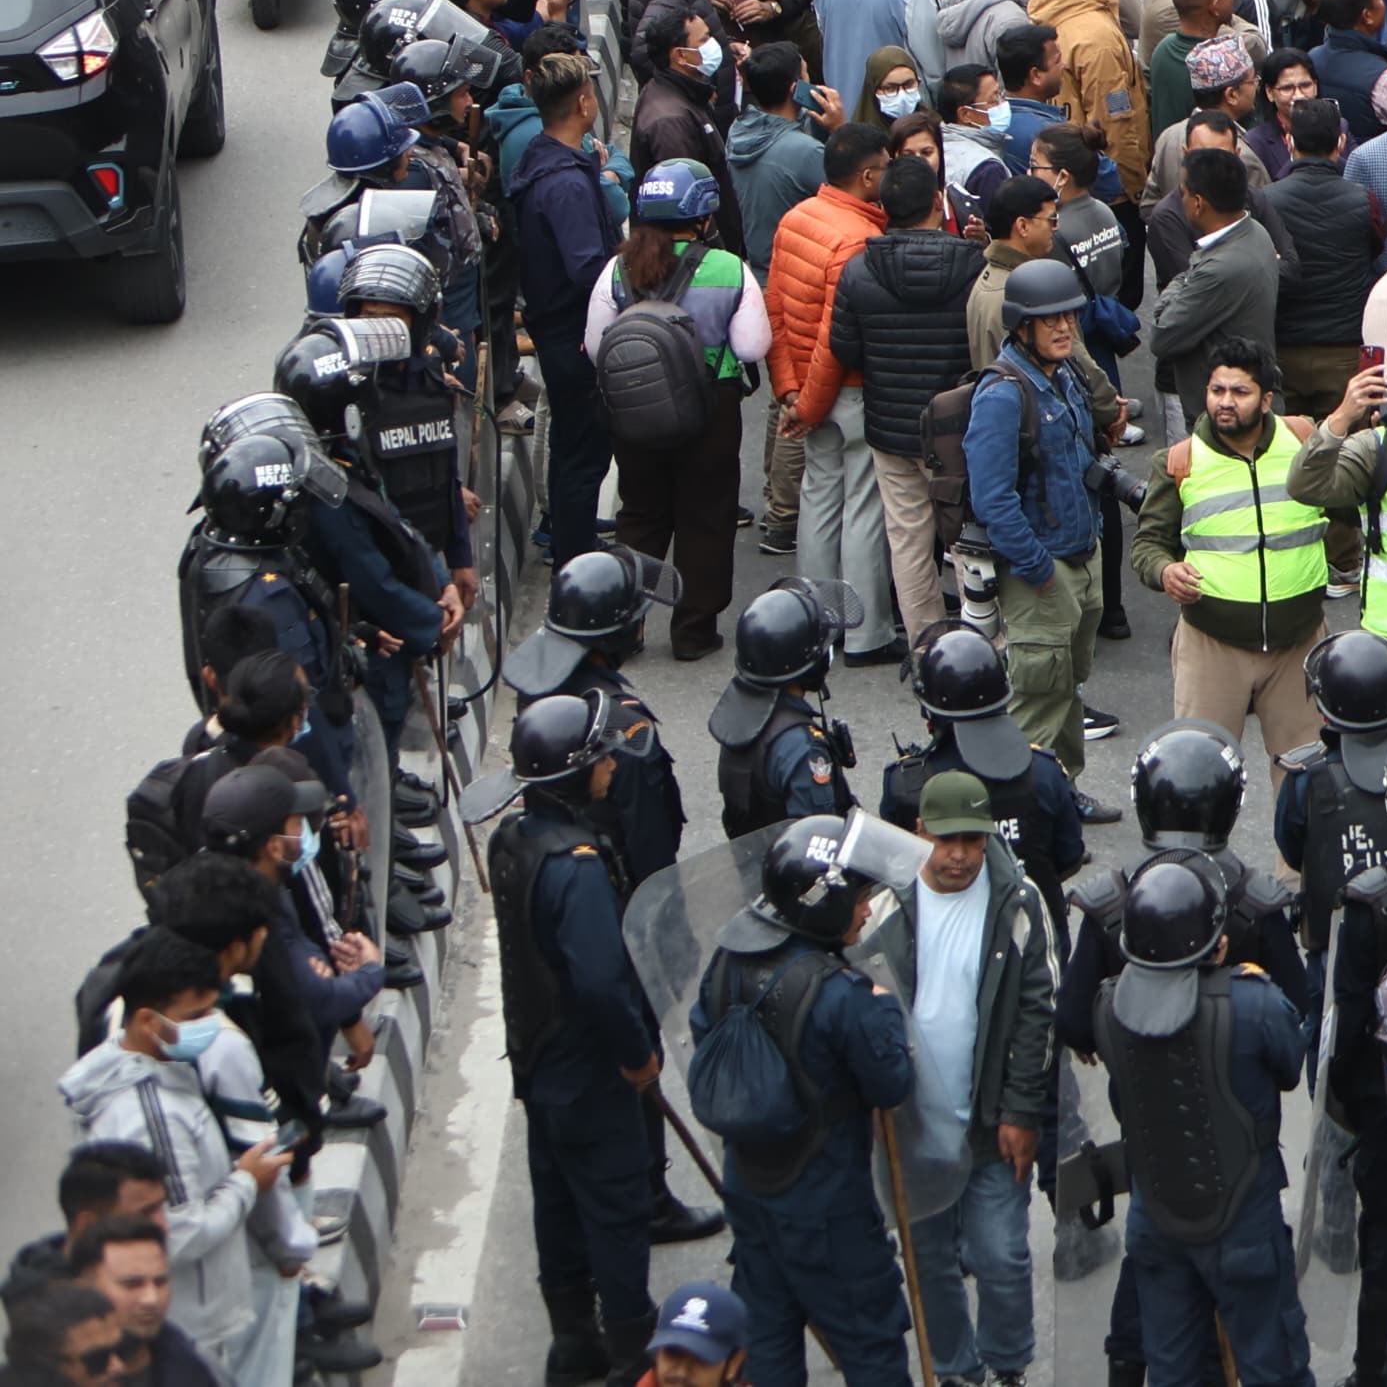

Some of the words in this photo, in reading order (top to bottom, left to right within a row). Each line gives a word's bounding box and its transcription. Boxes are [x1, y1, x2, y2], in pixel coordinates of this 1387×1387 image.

[391, 7, 418, 20] NEPA
[388, 15, 416, 29] POLIC
[1071, 239, 1093, 255] new
[316, 359, 349, 378] POLIC
[380, 425, 419, 451] NEPAL
[418, 418, 454, 445] POLICE
[254, 463, 292, 477] NEPA
[809, 835, 838, 851] NEP
[806, 846, 836, 863] POLI
